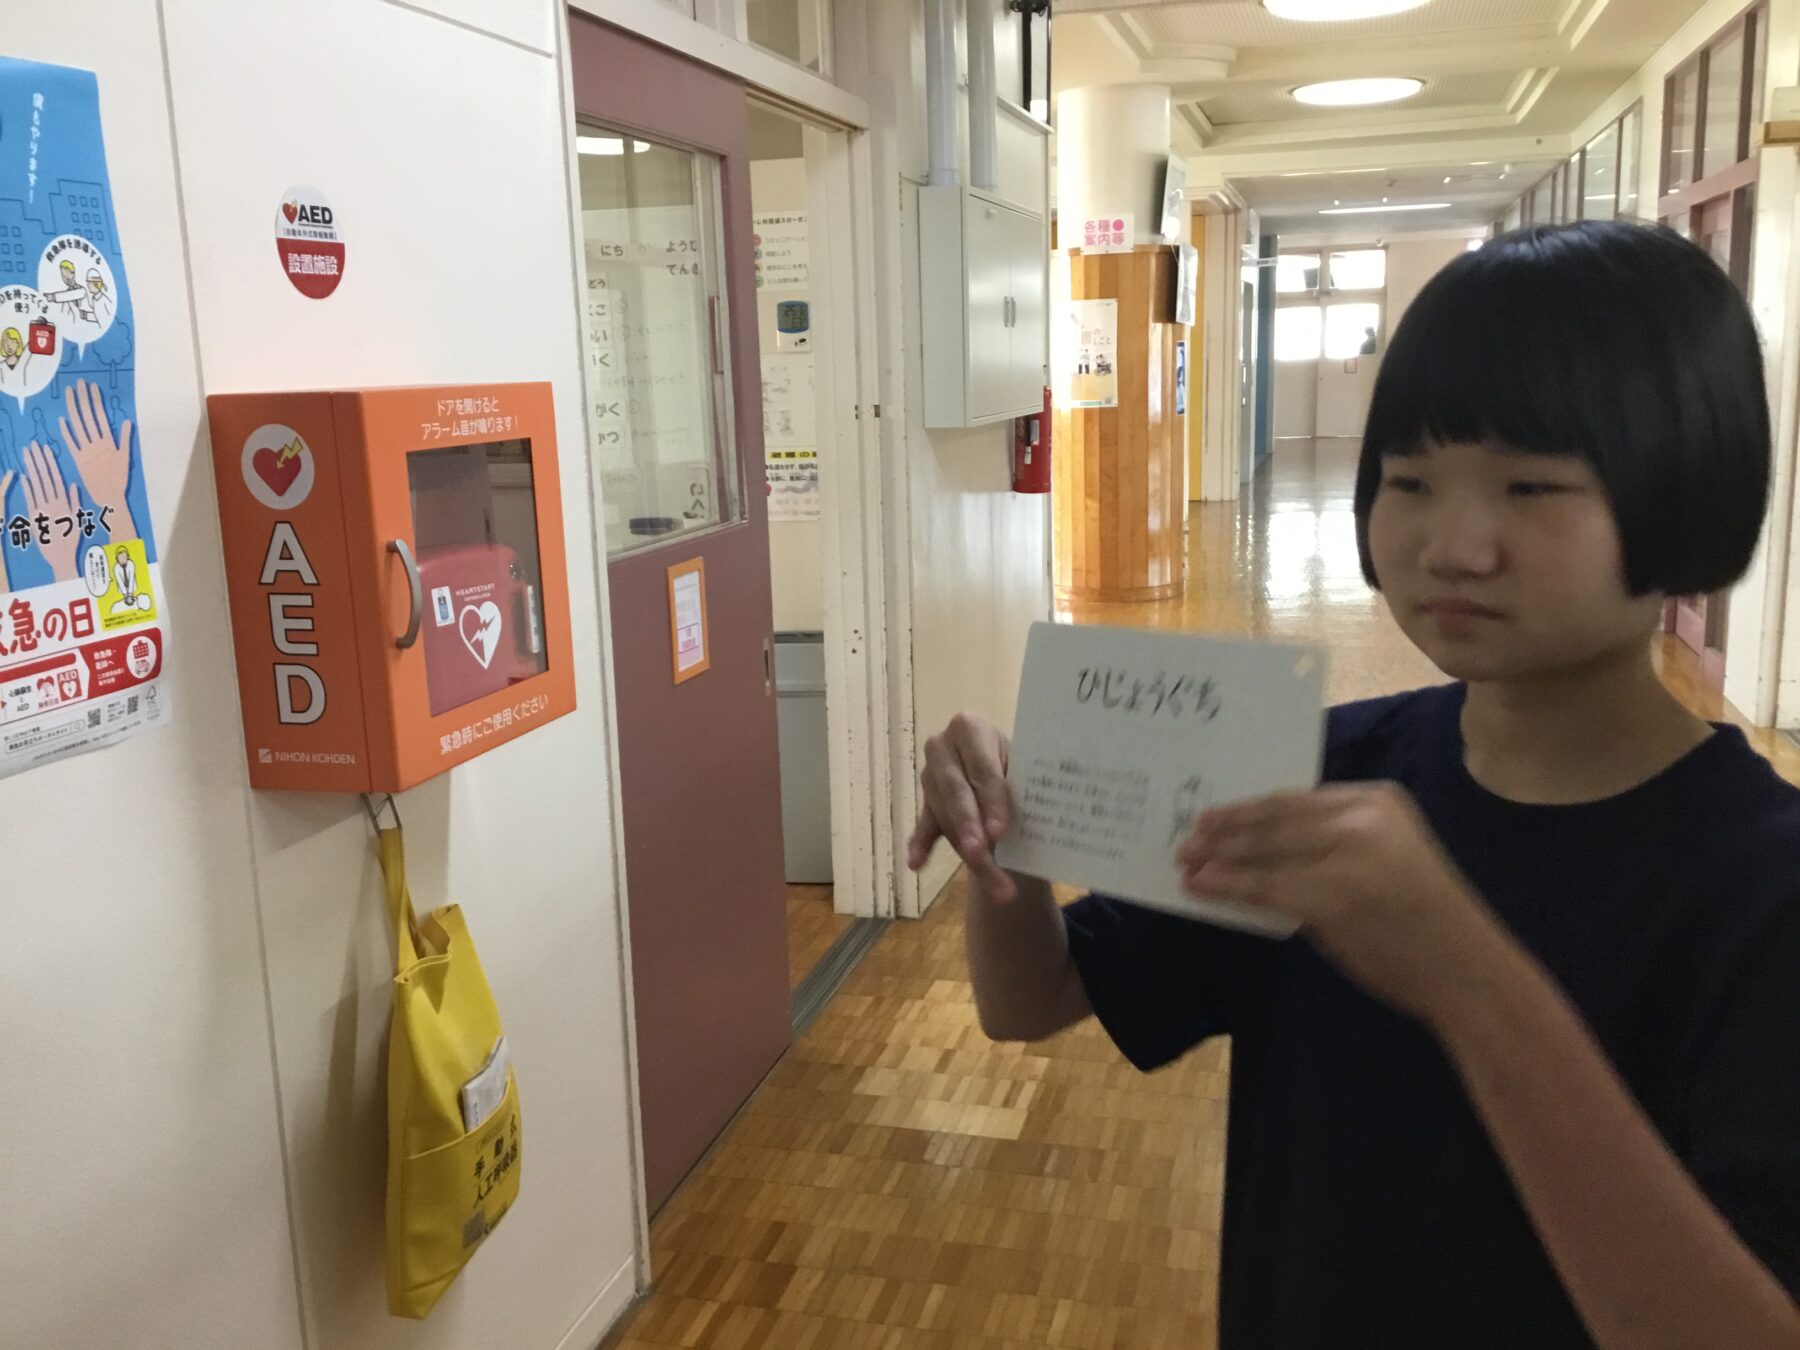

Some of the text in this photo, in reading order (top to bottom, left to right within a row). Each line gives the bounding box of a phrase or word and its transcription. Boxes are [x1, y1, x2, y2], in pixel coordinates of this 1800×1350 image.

[298, 204, 333, 225] AED
[600, 244, 624, 257] にち
[288, 252, 339, 275] 設置施設
[437, 396, 500, 417] ドアを開けると
[0, 505, 114, 549] 命をつなぐ
[258, 521, 327, 726] AED
[59, 670, 77, 682] AED
[440, 693, 549, 755] 緊急時にご使用ください
[275, 751, 356, 765] NIHON KOHDEN
